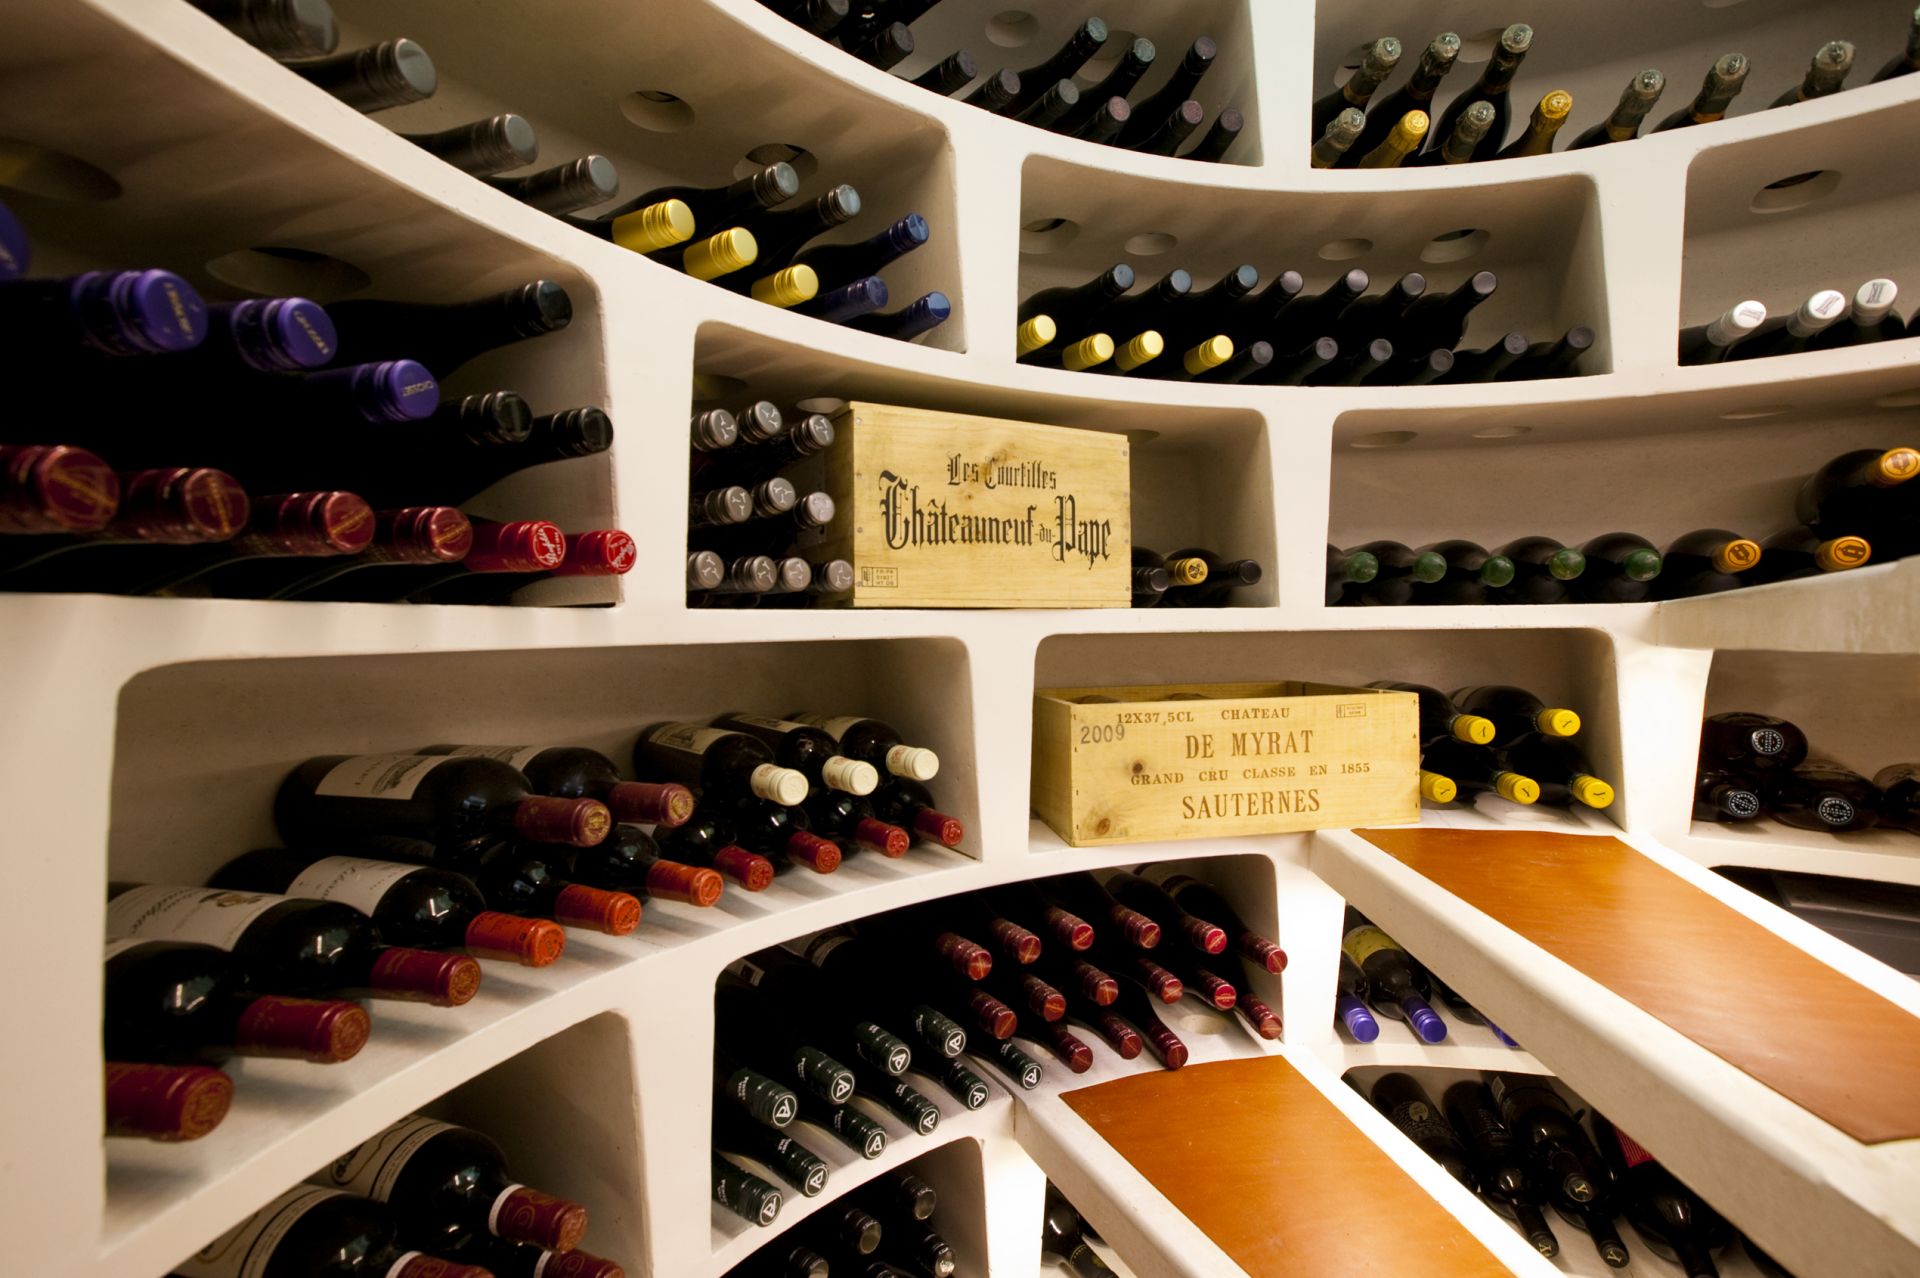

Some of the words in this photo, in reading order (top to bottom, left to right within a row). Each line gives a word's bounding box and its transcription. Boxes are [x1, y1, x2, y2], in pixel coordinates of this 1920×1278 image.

[946, 453, 979, 486] Les
[1221, 707, 1290, 720] CHATEAU
[1080, 724, 1126, 745] 2009
[1185, 734, 1215, 759] DE
[1231, 729, 1314, 757] MYRAT
[1130, 773, 1184, 786] GRAND
[1198, 769, 1229, 782] CRU
[1242, 766, 1296, 779] CLASSE
[1309, 764, 1328, 776] EN
[1340, 763, 1370, 774] 1855
[1182, 788, 1320, 819] SAUTERNES
